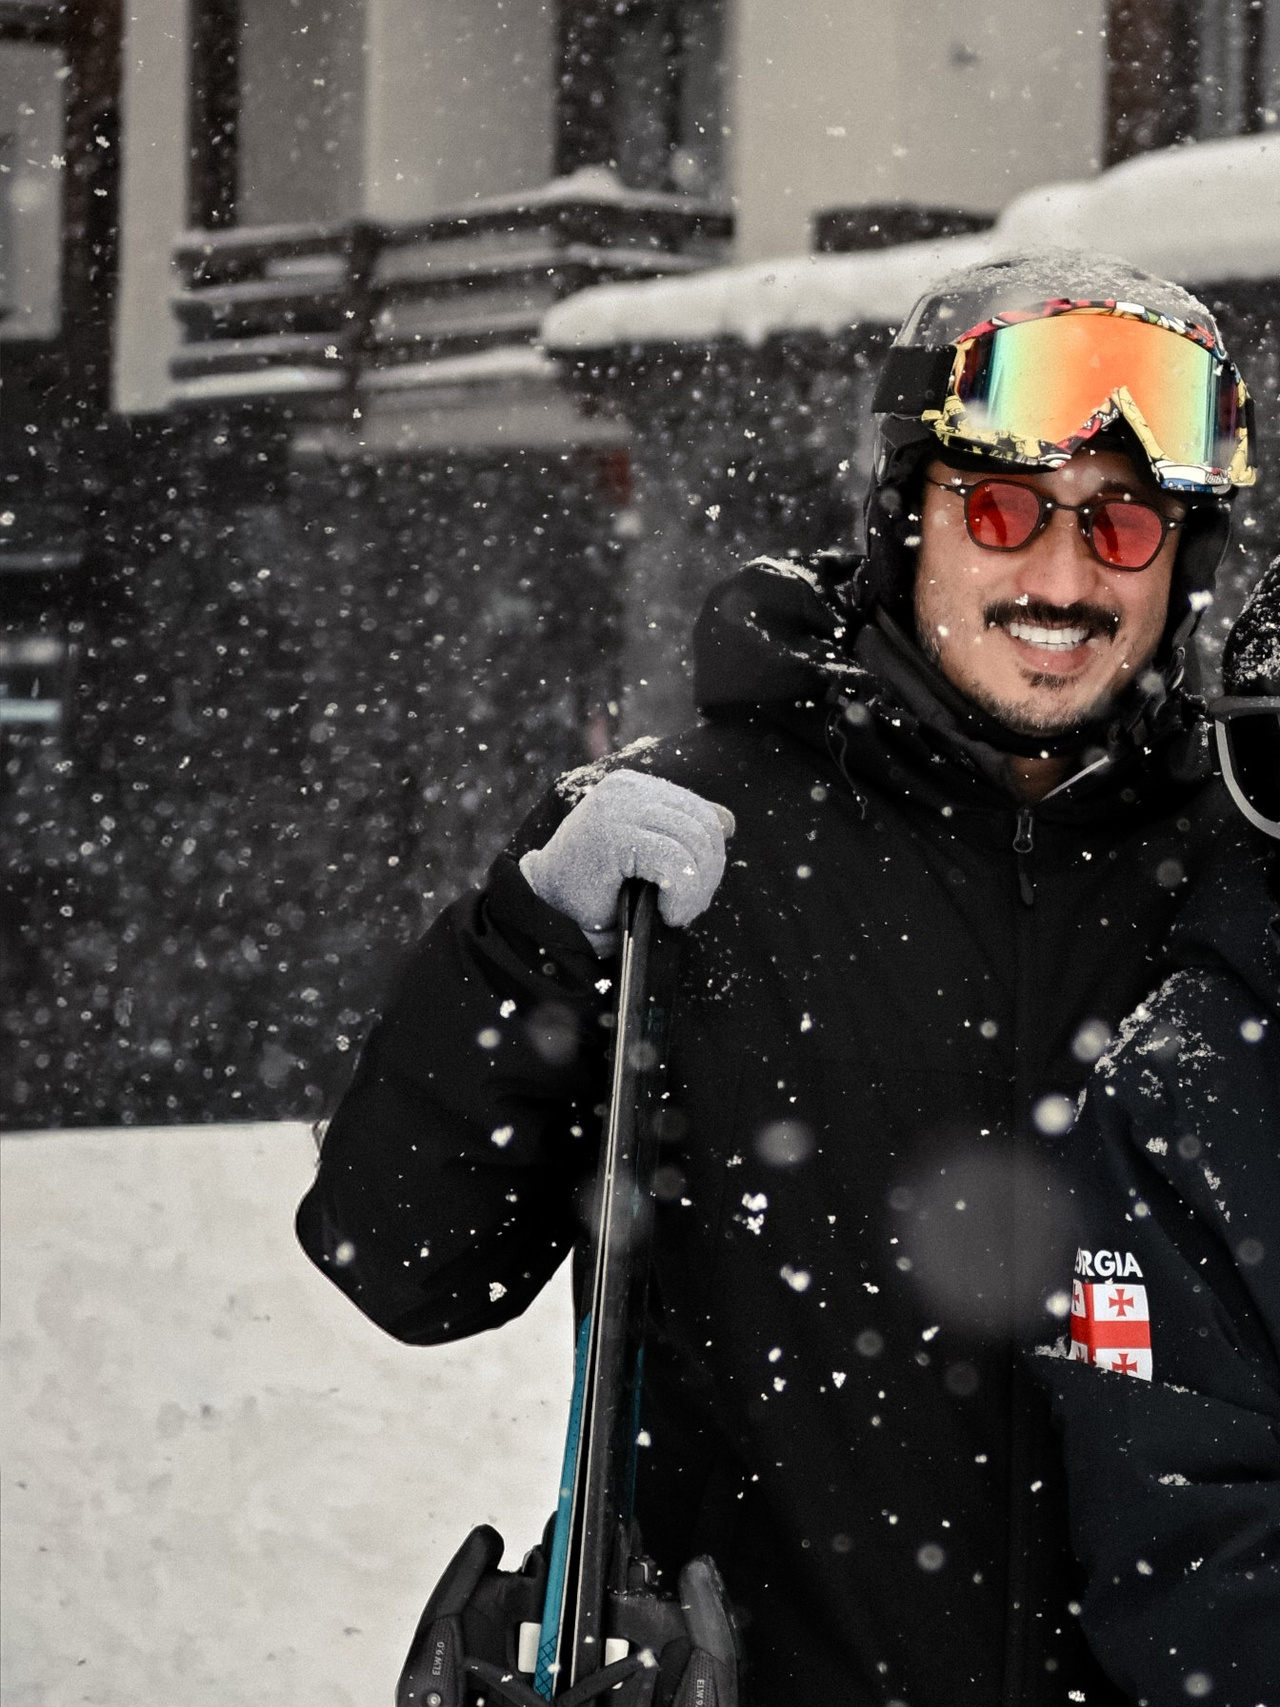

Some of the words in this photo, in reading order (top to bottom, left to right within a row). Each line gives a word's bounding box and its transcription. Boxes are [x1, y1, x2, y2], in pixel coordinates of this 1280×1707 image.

[436, 1641, 445, 1656] 9.0
[432, 1656, 442, 1675] ELW
[696, 1679, 705, 1699] ELW
